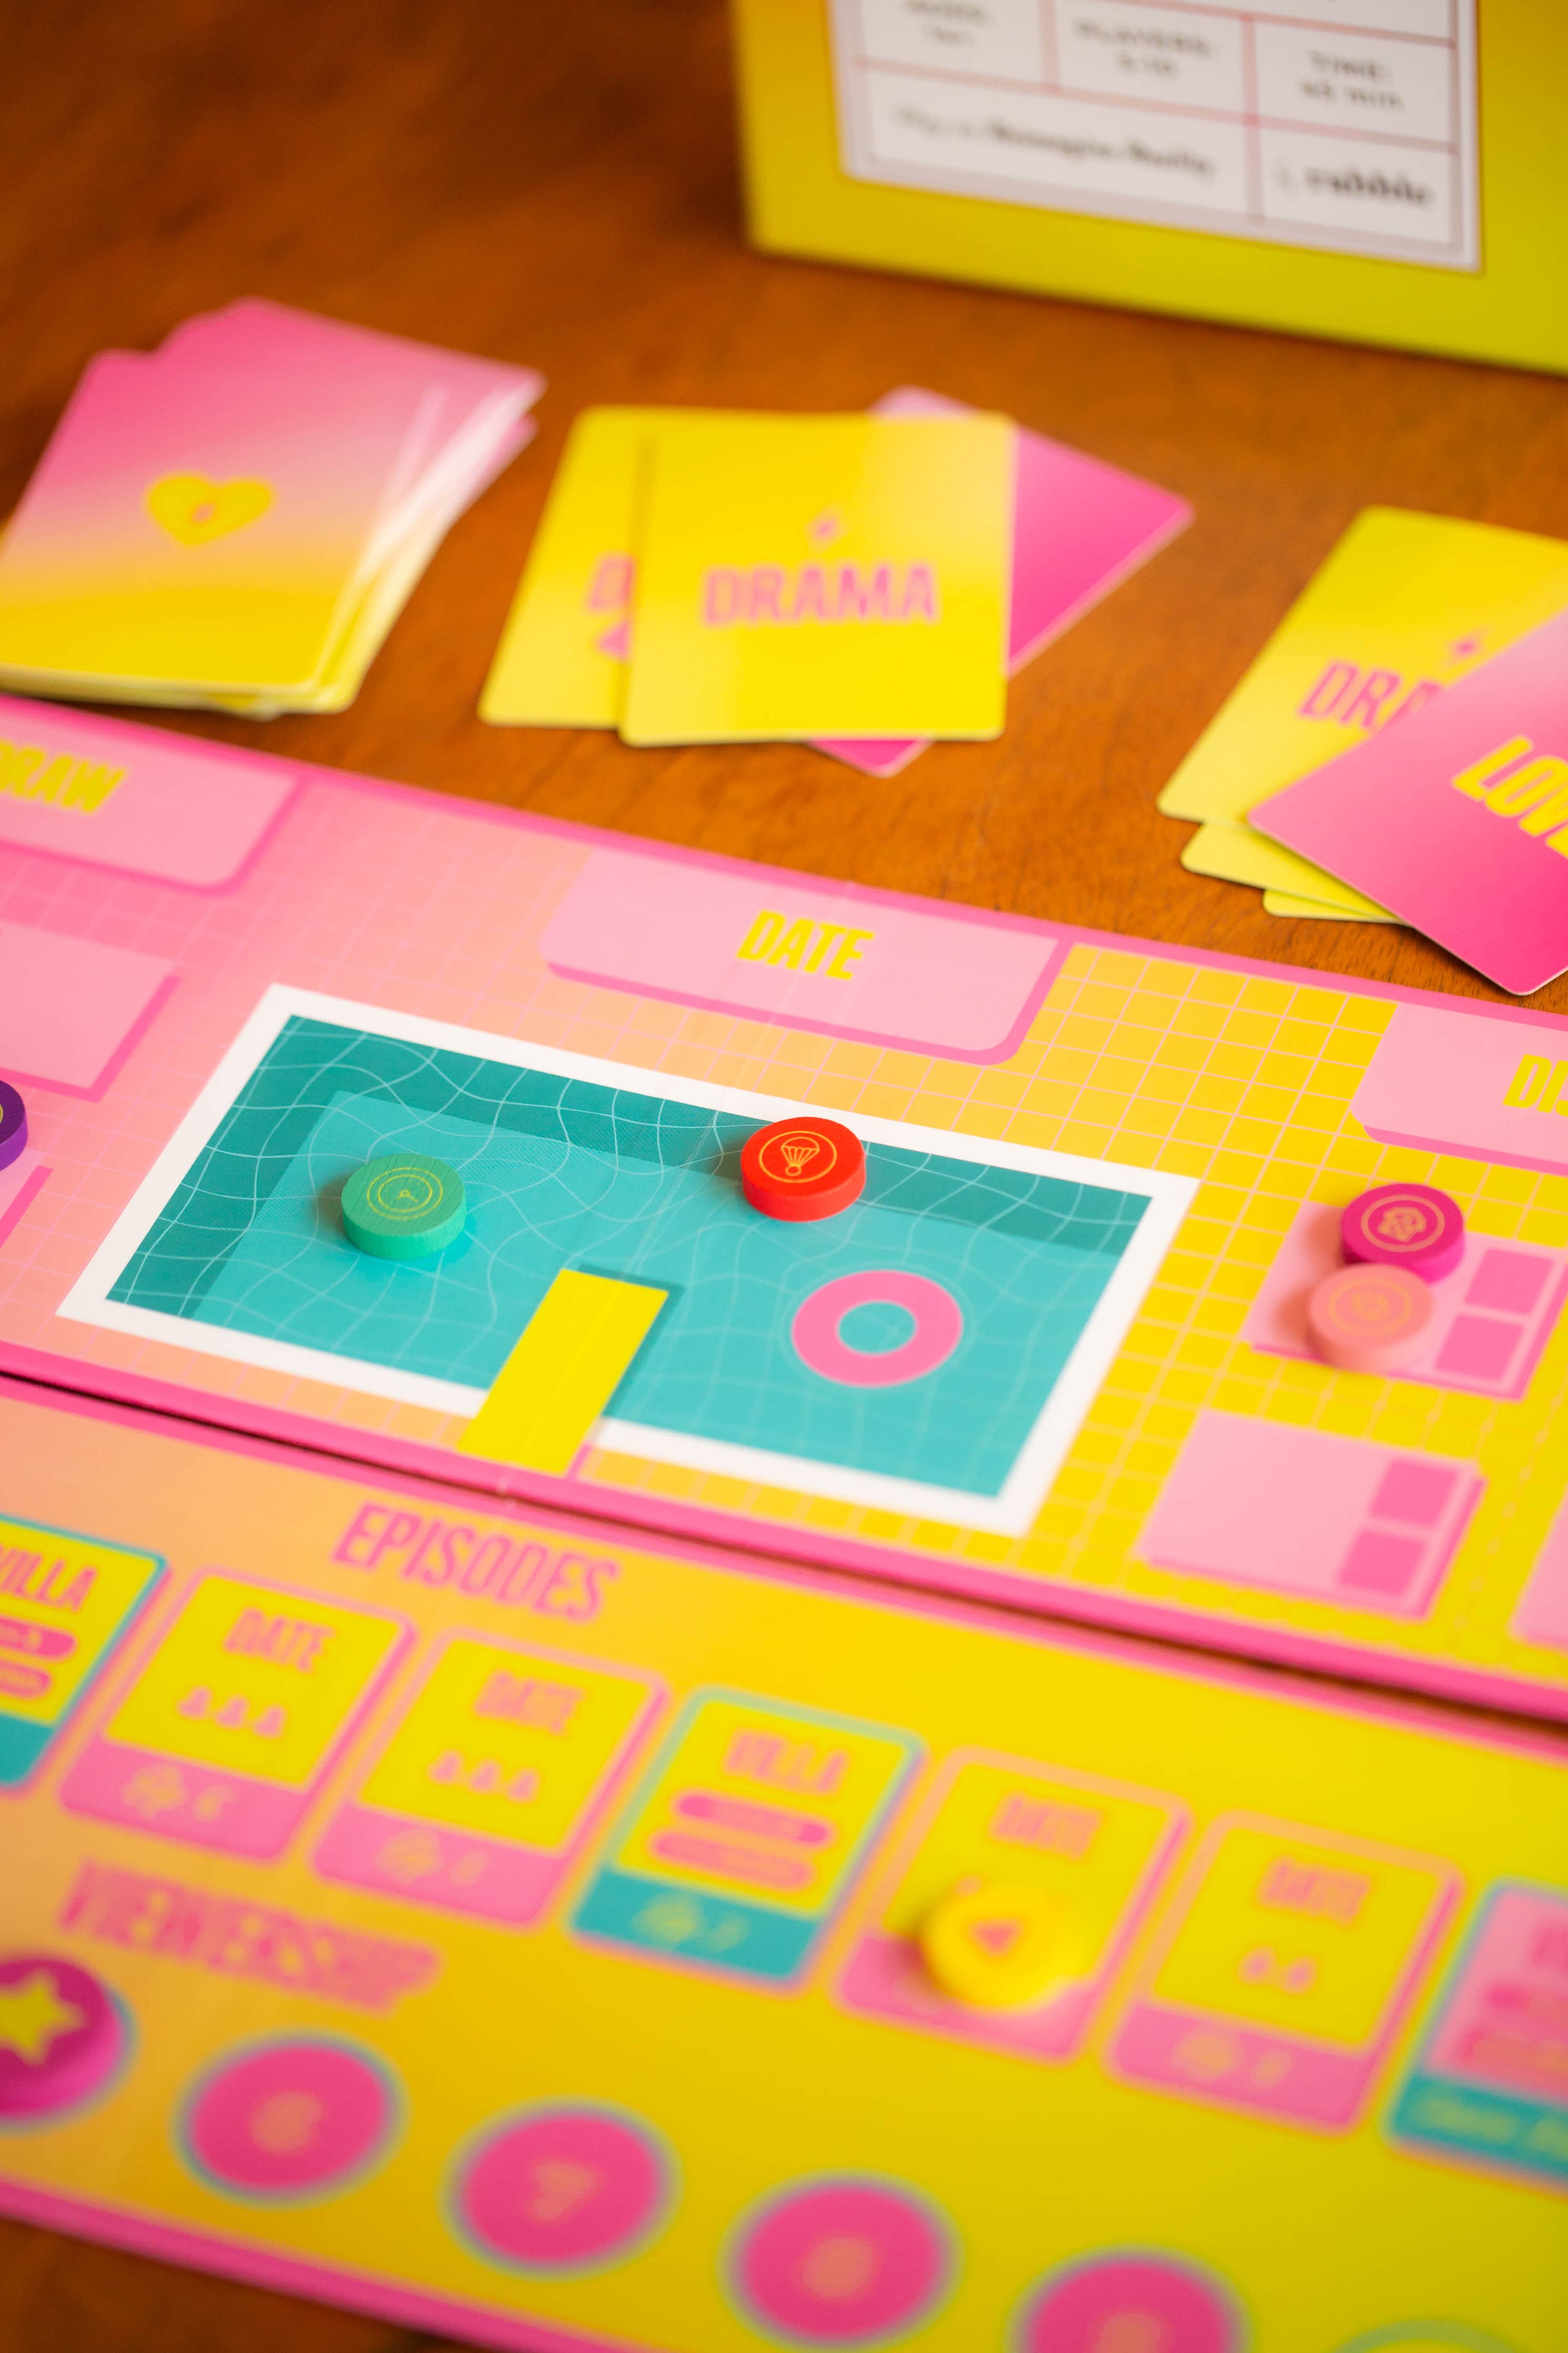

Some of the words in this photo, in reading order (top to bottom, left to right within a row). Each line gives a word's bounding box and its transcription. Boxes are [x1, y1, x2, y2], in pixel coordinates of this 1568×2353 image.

[703, 561, 938, 627] DRAMA
[736, 909, 875, 981] DATE
[332, 1501, 621, 1623] EPISODES
[223, 1606, 337, 1674] DATE
[474, 1668, 589, 1736] DATE
